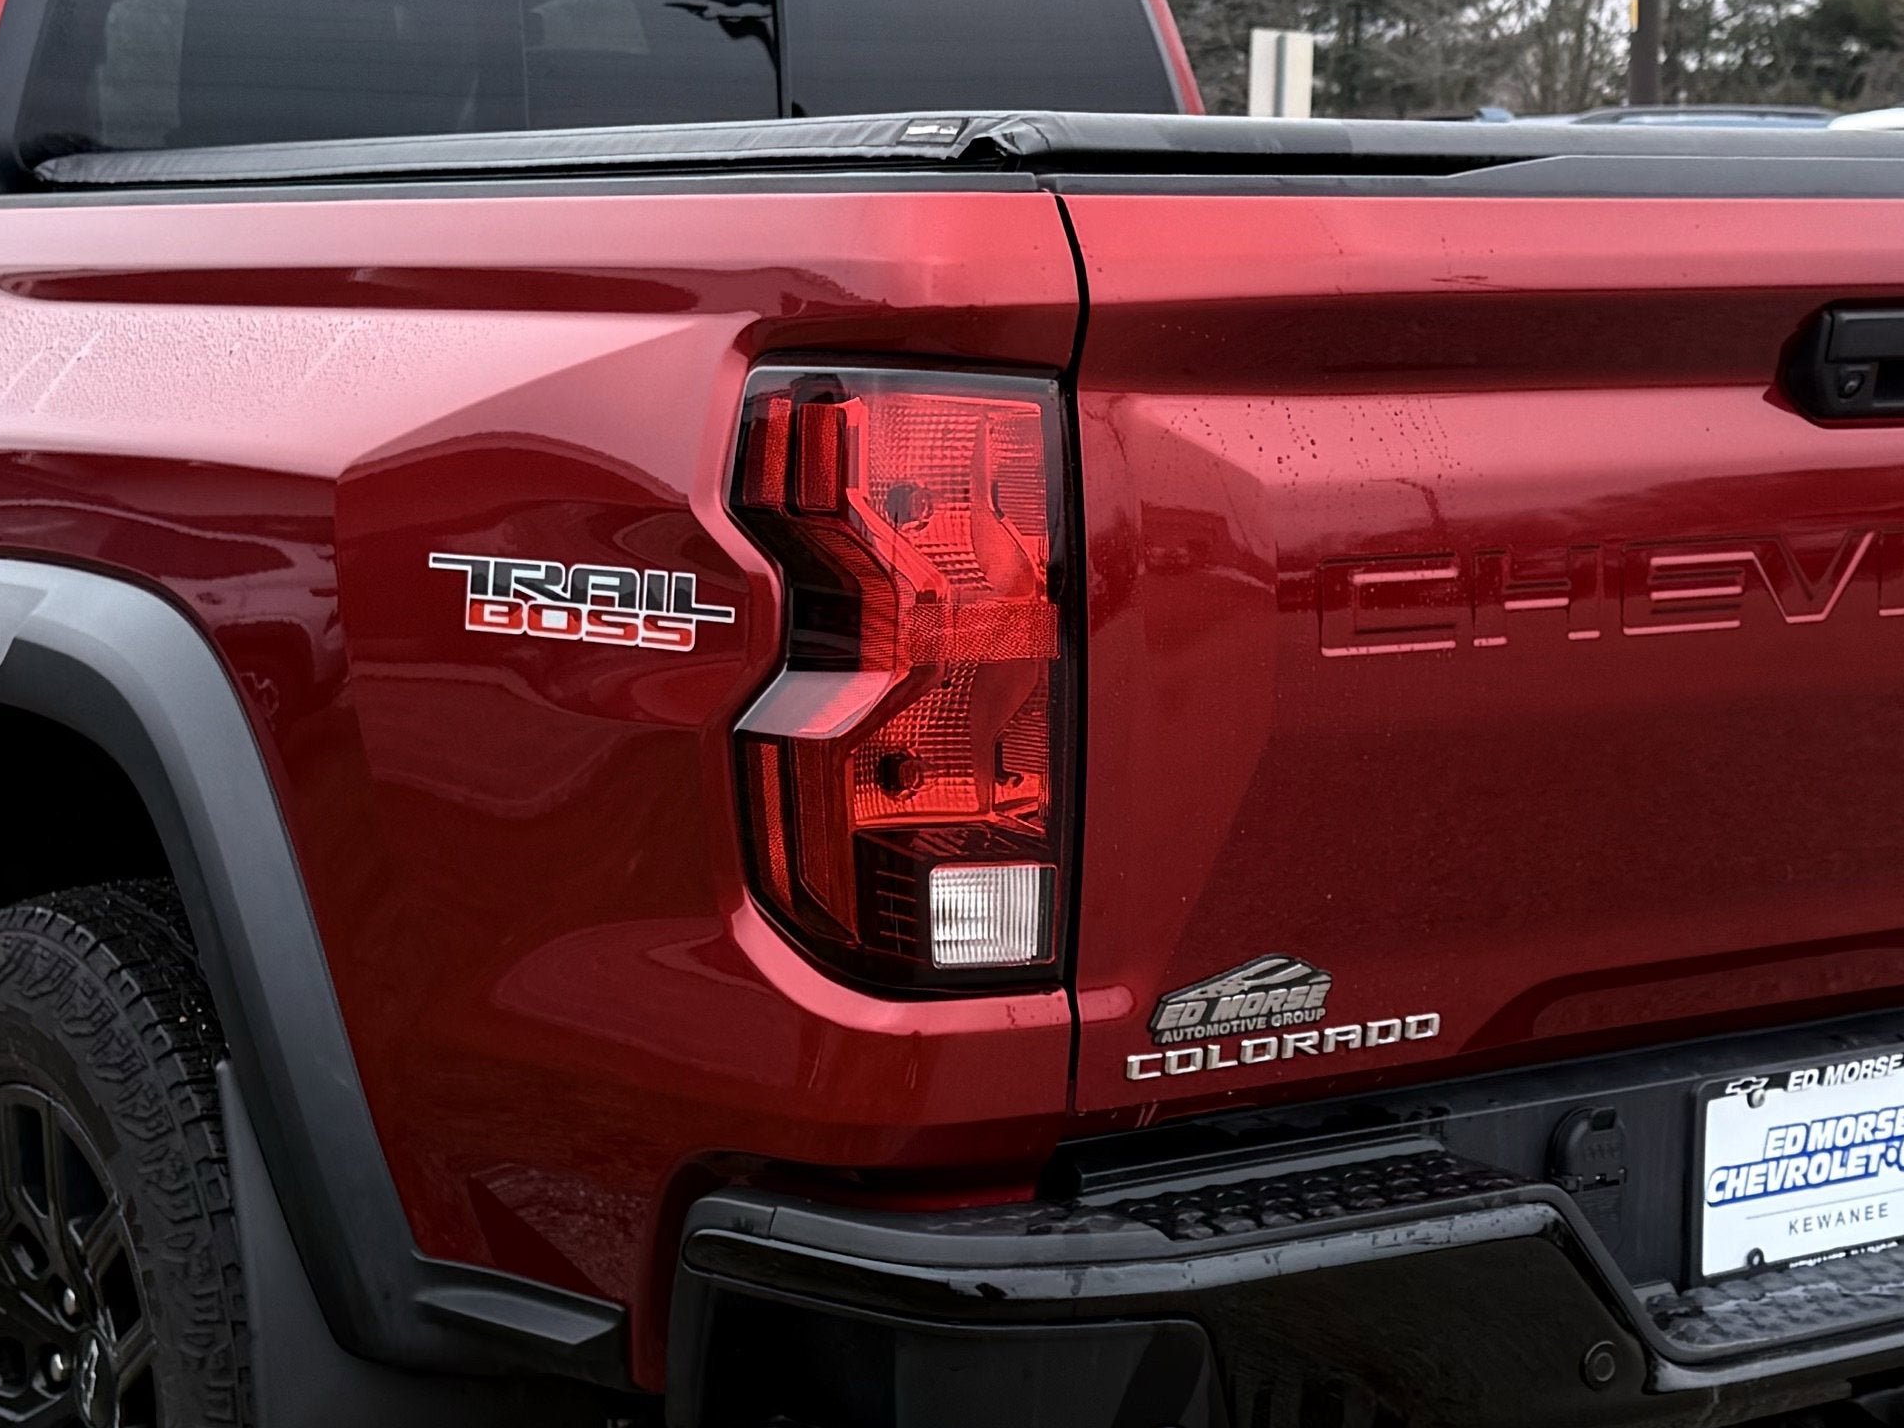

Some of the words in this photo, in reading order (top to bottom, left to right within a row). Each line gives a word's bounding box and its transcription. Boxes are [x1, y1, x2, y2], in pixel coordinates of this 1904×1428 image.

[429, 553, 735, 623] TRAIL
[465, 598, 695, 652] BOSS
[1157, 999, 1208, 1030] ED
[1211, 981, 1331, 1022] MORSE
[1161, 1016, 1267, 1044] AUTOMOTIVE
[1271, 1008, 1326, 1028] GROUP
[1126, 1013, 1440, 1080] COLORADO
[1787, 1069, 1819, 1092] ED
[1823, 1054, 1904, 1087] MORSE
[1764, 1126, 1810, 1160] ED
[1788, 1203, 1889, 1236] KEWANEE
